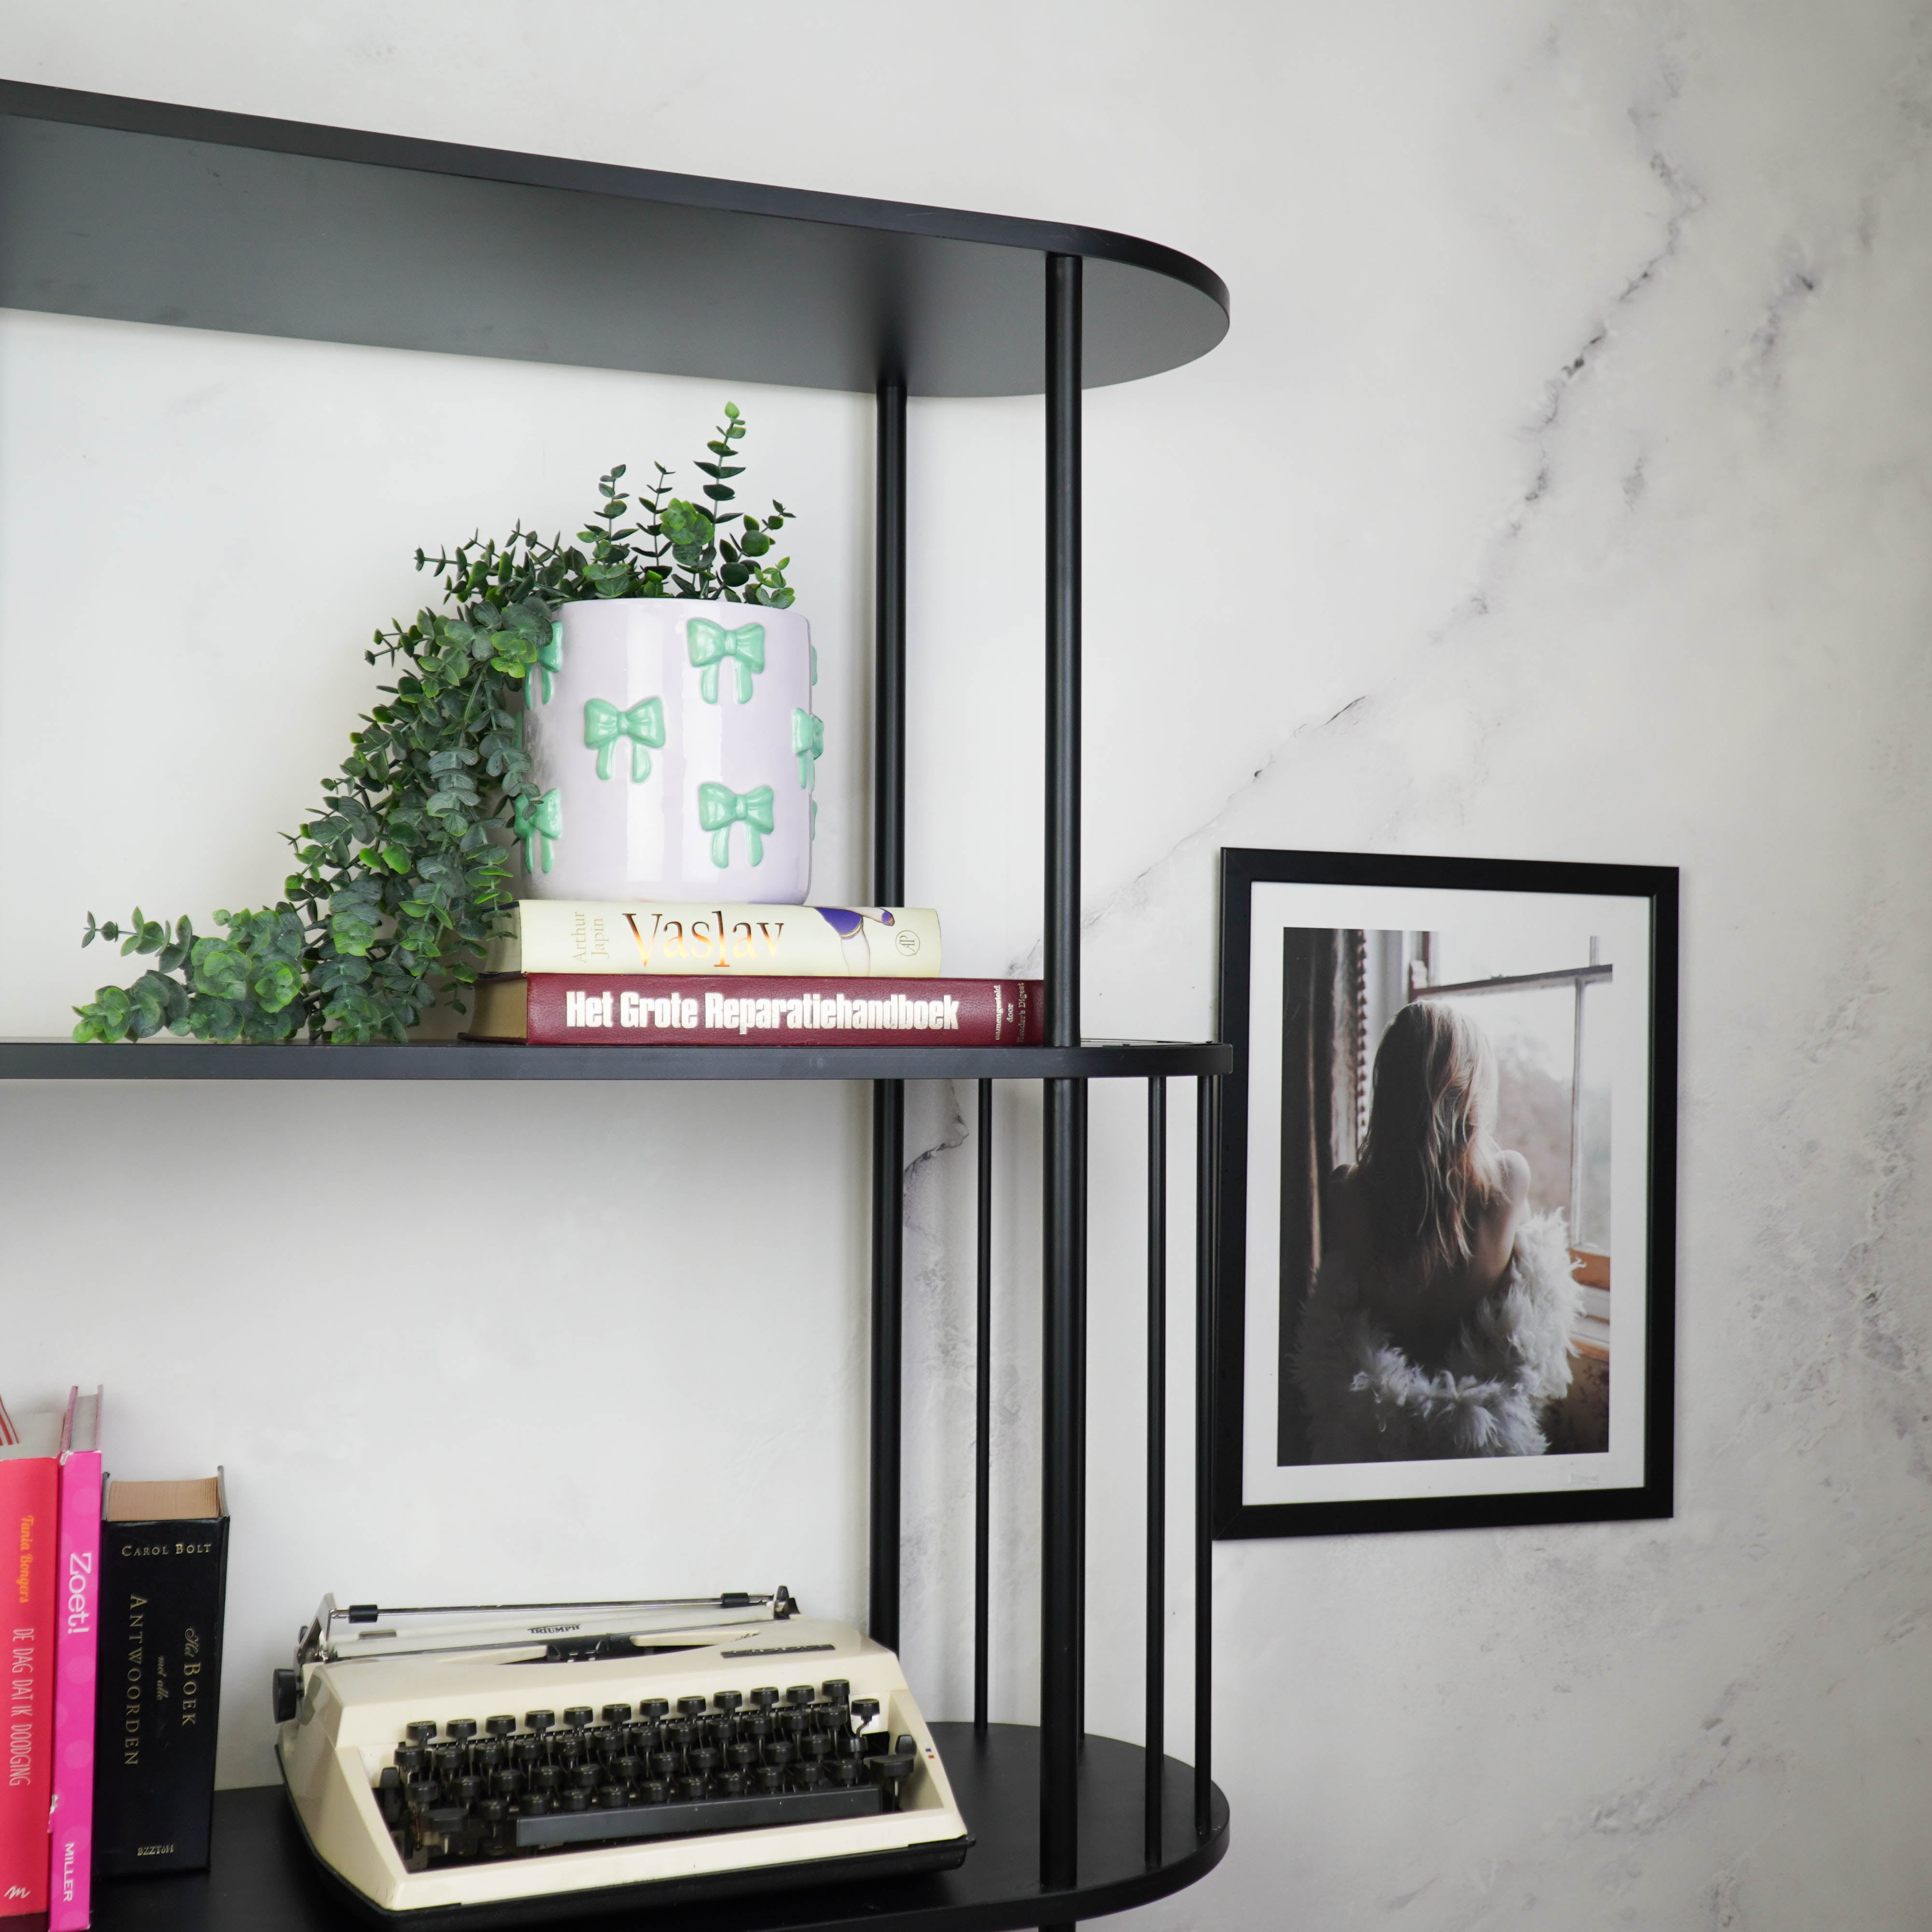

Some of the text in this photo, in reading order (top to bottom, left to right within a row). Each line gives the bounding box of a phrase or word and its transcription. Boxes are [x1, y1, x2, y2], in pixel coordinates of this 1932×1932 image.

[571, 911, 586, 963] Arthur
[591, 918, 610, 958] Japin
[622, 910, 784, 967] Vaslav
[566, 991, 959, 1035] Het Grote Reparatiehandboek
[994, 984, 1003, 1040] samengesteld
[1017, 982, 1027, 1008] Digest
[16, 1515, 34, 1603] Tania Bongers
[122, 1543, 212, 1556] CAROL BOLT
[68, 1553, 92, 1635] Zoet!
[527, 1623, 581, 1634] TRIUMPH
[9, 1628, 34, 1786] DE DAG DAT IK DOODGING
[125, 1594, 148, 1766] ANTWOORDEN
[182, 1662, 201, 1726] BOEK
[62, 1842, 74, 1902] MILLER
